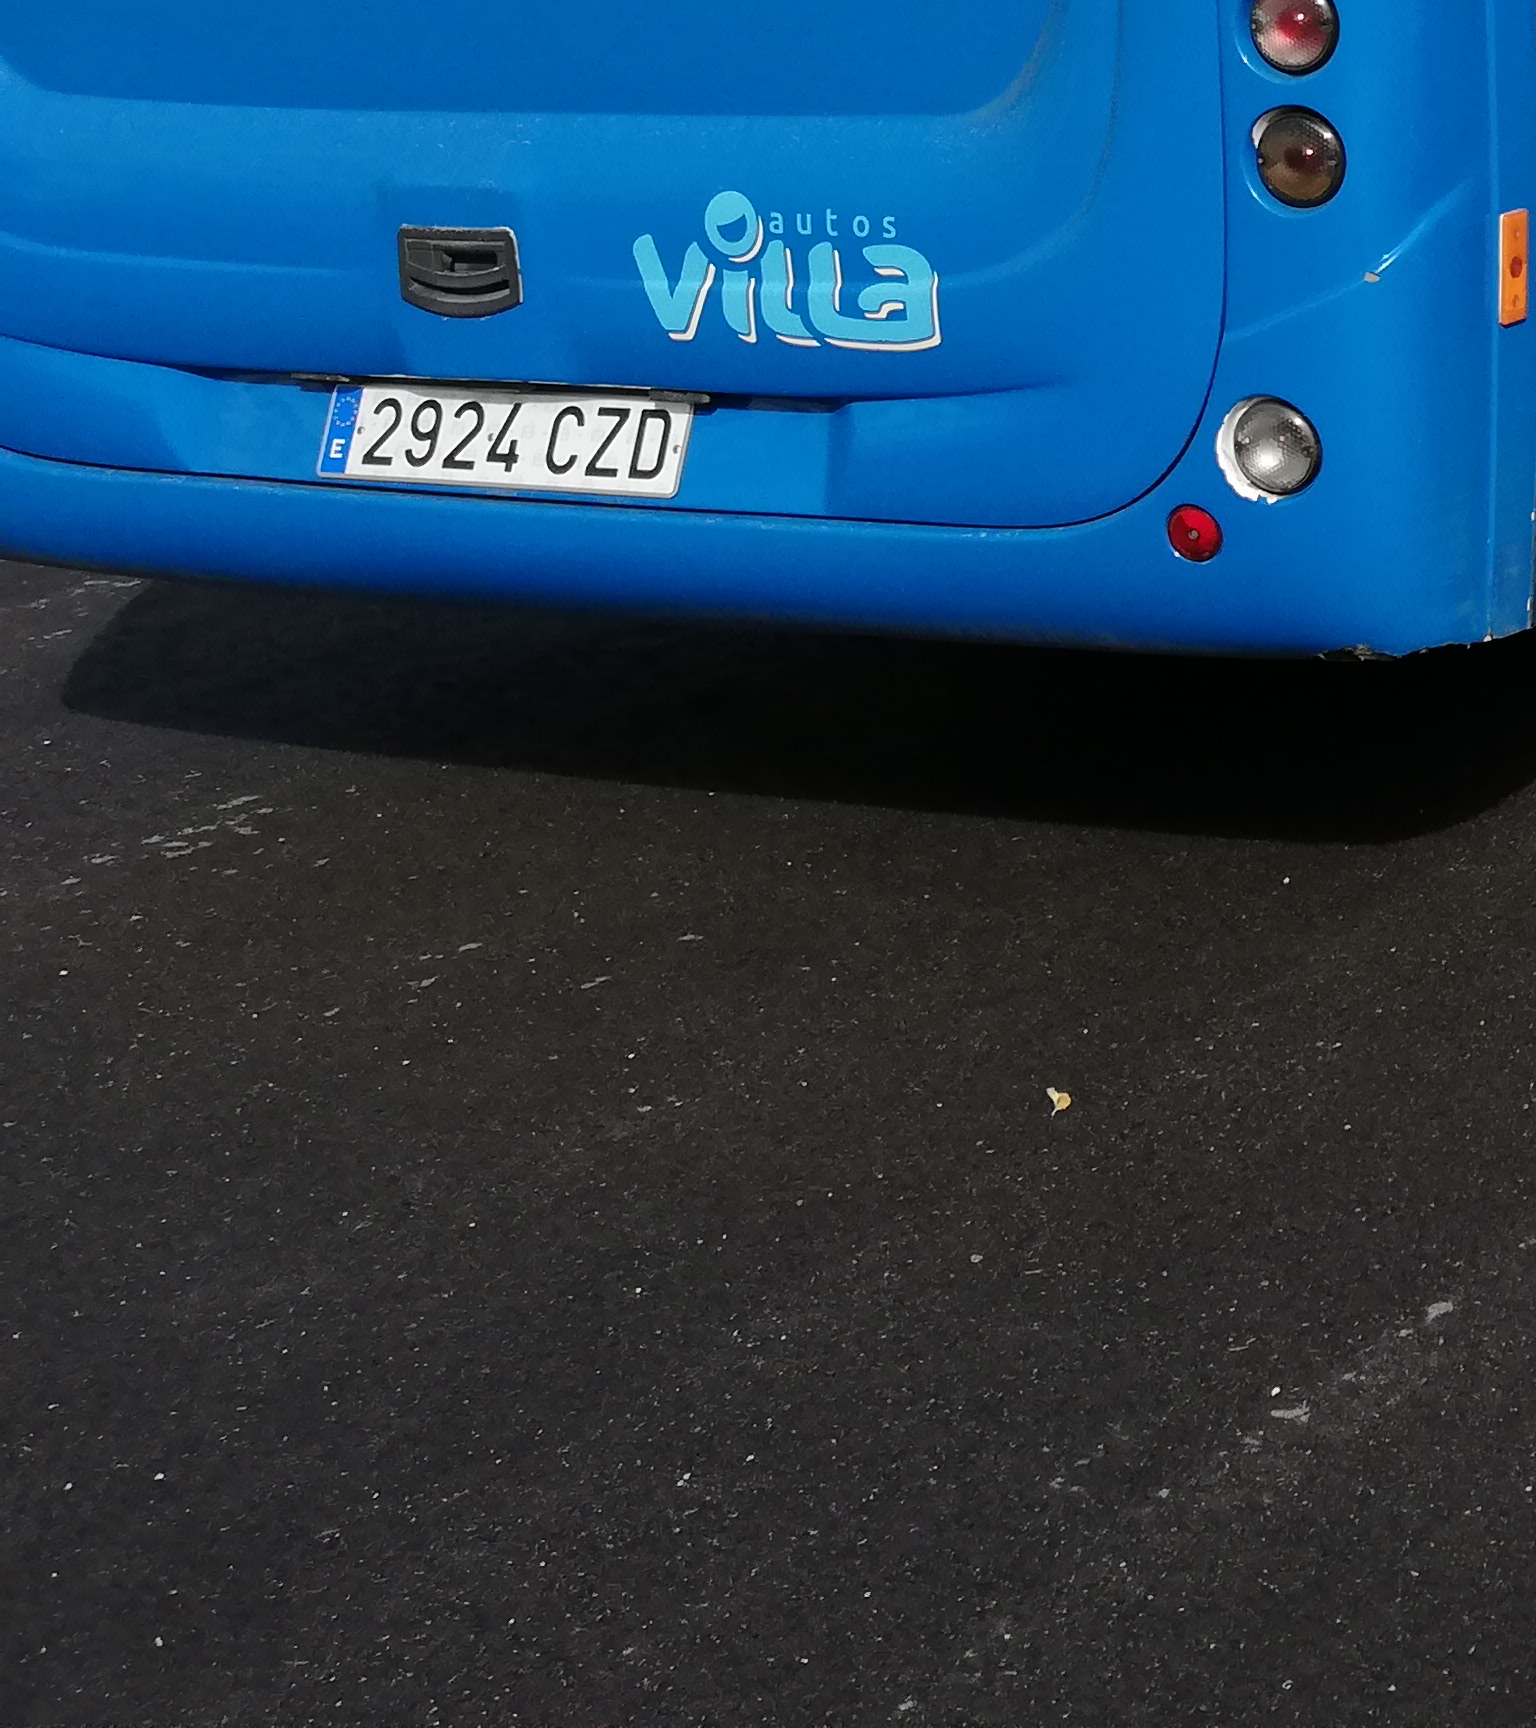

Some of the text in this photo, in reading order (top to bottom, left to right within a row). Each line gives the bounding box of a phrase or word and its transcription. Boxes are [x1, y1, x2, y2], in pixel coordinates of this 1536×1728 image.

[769, 209, 896, 238] autos
[330, 397, 674, 481] E 2924 CZD
